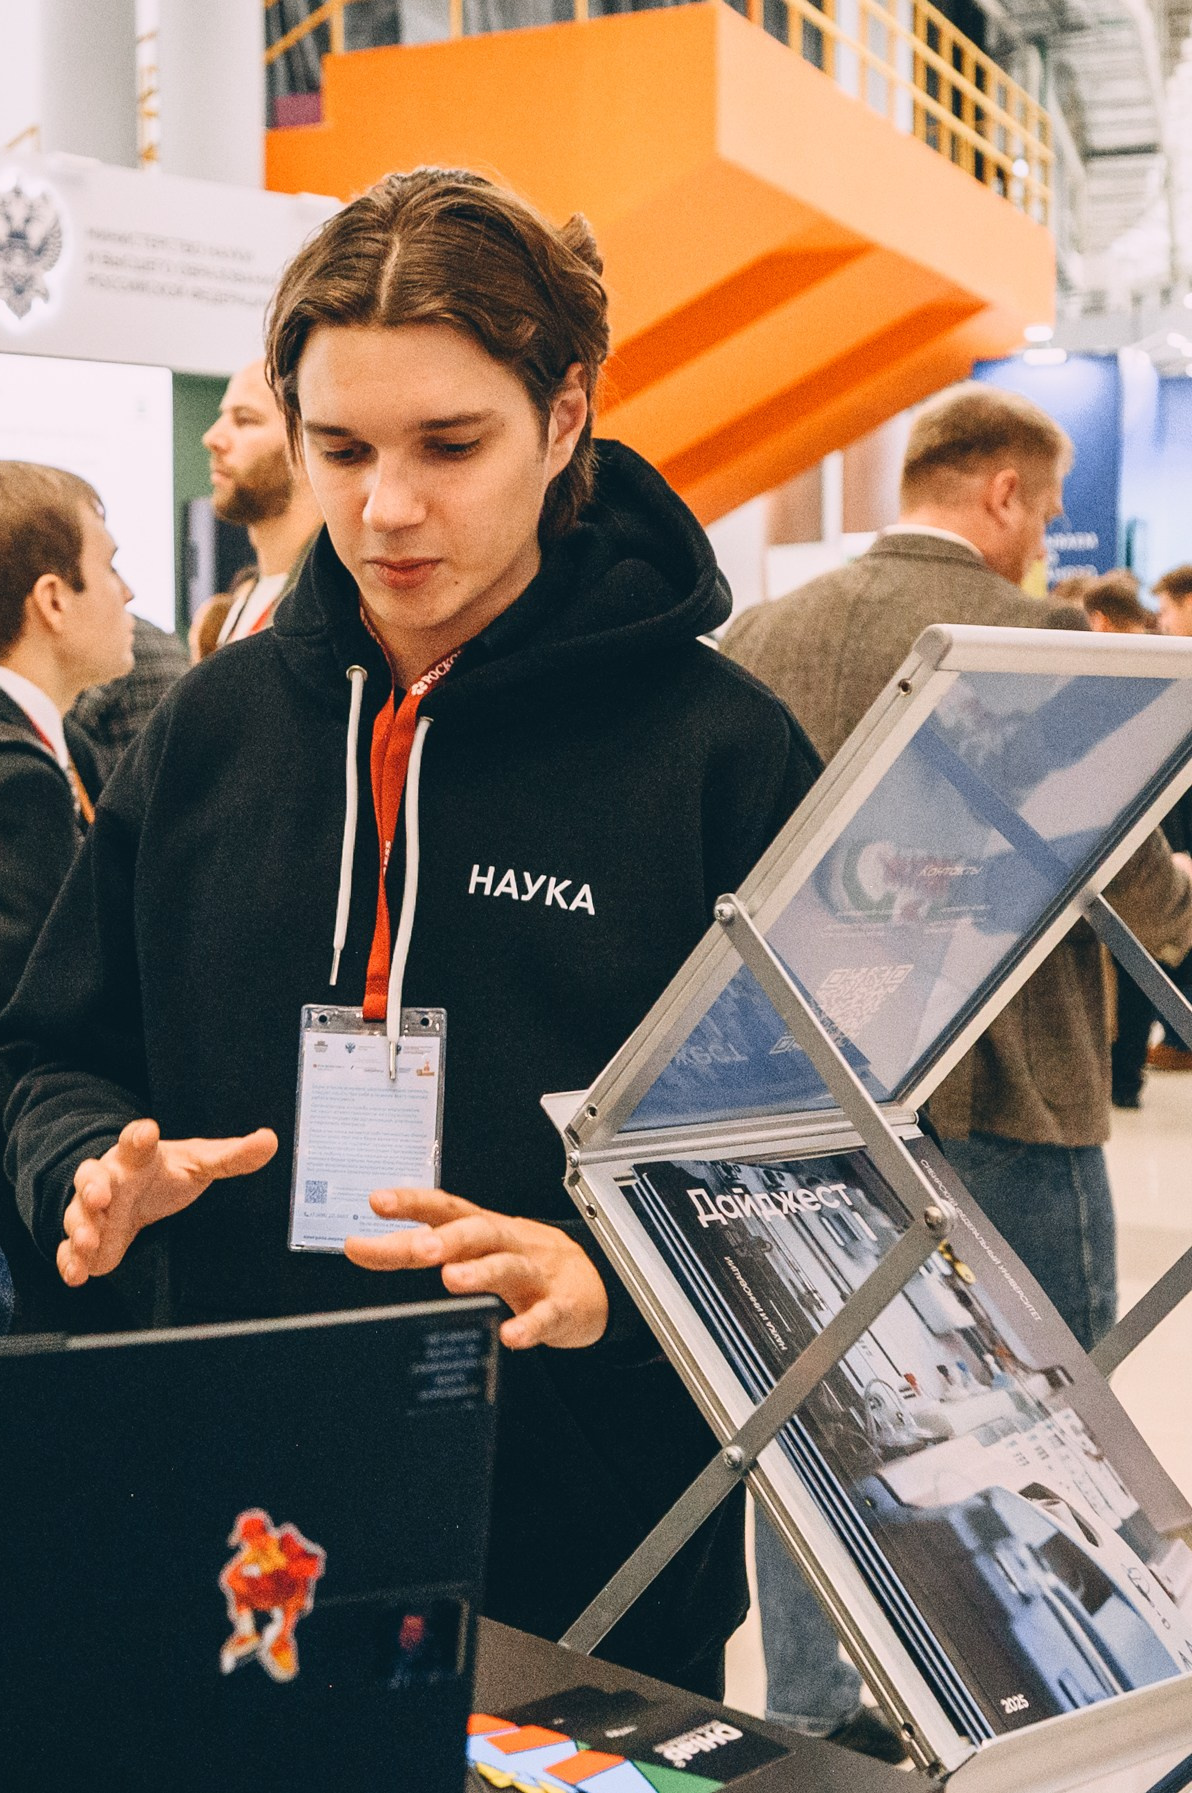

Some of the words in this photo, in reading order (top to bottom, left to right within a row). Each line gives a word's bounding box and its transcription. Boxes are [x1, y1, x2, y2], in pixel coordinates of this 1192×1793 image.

[468, 864, 596, 916] НАУКА
[686, 1183, 853, 1228] Дайджест
[724, 1256, 763, 1313] ИННОВАЦИИ
[998, 1265, 1042, 1321] УНИВЕРСИТЕТ
[765, 1321, 788, 1351] НАУКА
[1000, 1693, 1029, 1714] 2025
